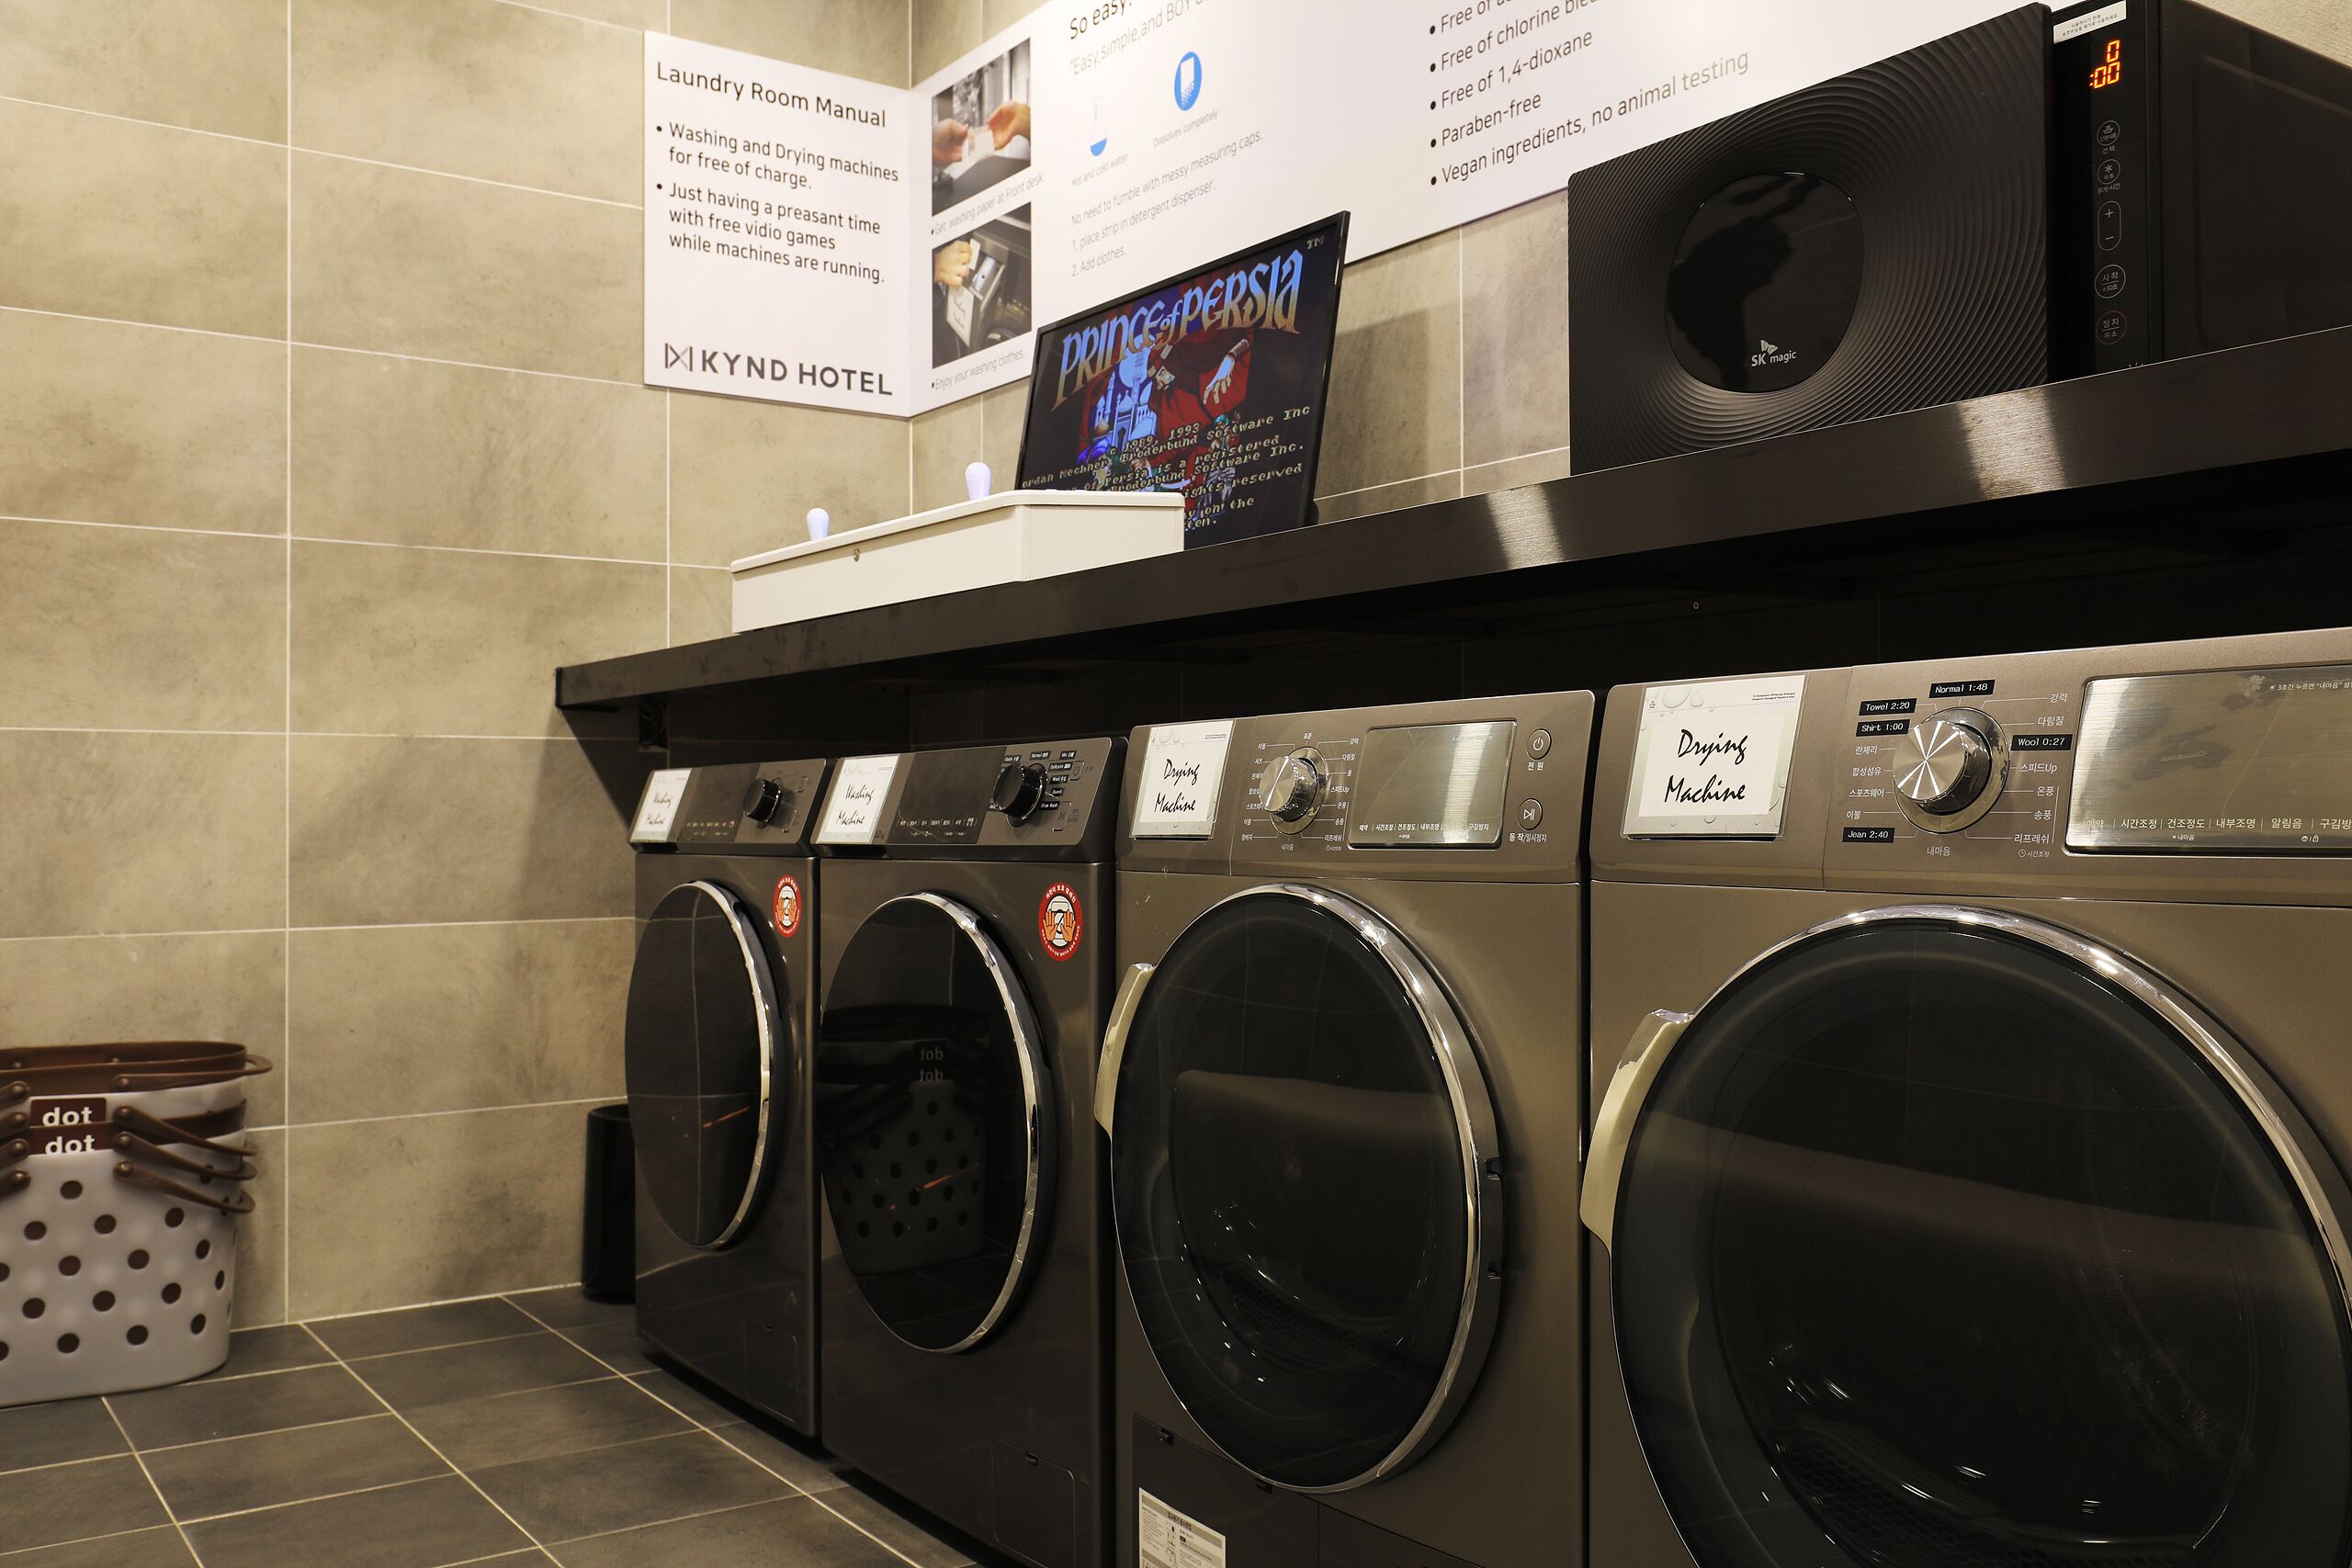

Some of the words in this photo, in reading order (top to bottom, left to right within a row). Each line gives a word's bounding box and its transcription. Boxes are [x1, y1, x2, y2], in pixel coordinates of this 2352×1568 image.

[1069, 16, 1089, 40] So
[1441, 6, 1474, 33] Free
[1441, 42, 1474, 71] Free
[1476, 30, 1494, 54] of
[1497, 6, 1560, 46] chlorine
[2106, 39, 2120, 63] 0
[1442, 83, 1474, 108] Free
[1477, 69, 1493, 92] of
[1498, 30, 1593, 85] 1,4-dioxane
[657, 61, 745, 102] Laundry
[752, 82, 808, 111] Room
[816, 96, 887, 128] Manual
[1442, 153, 1487, 184] Vegan
[1491, 114, 1588, 165] ingredients,
[1591, 105, 1612, 127] no
[1617, 75, 1677, 117] animal
[1681, 51, 1749, 93] testing
[1442, 93, 1542, 148] Paraben-free
[669, 121, 738, 153] Washing
[742, 138, 772, 157] and
[775, 143, 826, 172] Drying
[830, 155, 899, 183] machines
[669, 146, 693, 165] for
[697, 151, 730, 173] free
[735, 161, 754, 177] of
[754, 164, 813, 189] charge.
[1071, 212, 1082, 227] No
[1082, 202, 1102, 222] need
[1102, 199, 1113, 212] to
[1141, 175, 1160, 197] with
[1160, 164, 1190, 187] messy
[1190, 142, 1238, 173] measuring
[669, 181, 704, 202] Just
[707, 187, 760, 217] having
[763, 201, 774, 215] a
[777, 203, 844, 229] preasant
[847, 214, 881, 235] time
[669, 208, 704, 228] with
[708, 212, 741, 234] free
[745, 220, 783, 241] vidio
[786, 227, 837, 251] games
[1080, 231, 1100, 253] place
[1120, 218, 1129, 231] in
[1129, 198, 1170, 228] detergent
[669, 232, 712, 254] while
[716, 240, 791, 266] machines
[794, 253, 820, 271] are
[822, 259, 886, 286] running.
[1080, 255, 1097, 274] Add
[1050, 299, 1166, 412] PRINCE
[1178, 249, 1304, 339] PERSIA
[1751, 354, 1767, 367] SK
[1770, 350, 1797, 364] magic
[702, 348, 788, 382] KYND
[798, 362, 894, 396] HOTEL
[1169, 423, 1201, 440] 1993
[1158, 462, 1172, 474] is
[1022, 473, 1055, 490] ordan
[1184, 481, 1225, 499] ights
[1231, 462, 1303, 488] reserved
[1934, 683, 1965, 694] Normal
[1968, 682, 1989, 693] 1:48
[2049, 692, 2069, 704] 강력
[1864, 702, 1889, 712] Towel
[1890, 700, 1910, 711] 2:20
[1860, 723, 1882, 733] Shirt
[1884, 721, 1905, 731] 1:00
[2037, 715, 2065, 728] 다림질
[1677, 728, 1748, 767] Drying
[1854, 745, 1878, 756] 란제리
[2017, 737, 2041, 748] Wool
[2041, 736, 2066, 747] 0:27
[1163, 758, 1201, 786] Drying
[1851, 766, 1883, 777] 합성섬유
[2018, 762, 2059, 774] 스피드Up
[844, 783, 875, 808] Washing
[1664, 773, 1747, 805] Machine
[1849, 788, 1884, 798] 스포츠웨어
[2035, 785, 2055, 797] 온풍
[1154, 792, 1197, 813] Machine
[835, 809, 865, 828] Machine
[1846, 809, 1861, 820] 이불
[2033, 809, 2052, 821] 송풍
[2120, 818, 2158, 829] 시간조정
[2166, 818, 2206, 829] 건조정도
[2215, 818, 2256, 829] 내부조명
[2271, 817, 2303, 829] 알림음
[2319, 818, 2352, 830] 구김방
[1847, 829, 1867, 840] Jean
[1869, 829, 1890, 840] 2:40
[2013, 834, 2051, 845] 리프레쉬
[1926, 845, 1951, 857] 내마음
[41, 1106, 93, 1127] dot
[45, 1134, 96, 1156] dot
